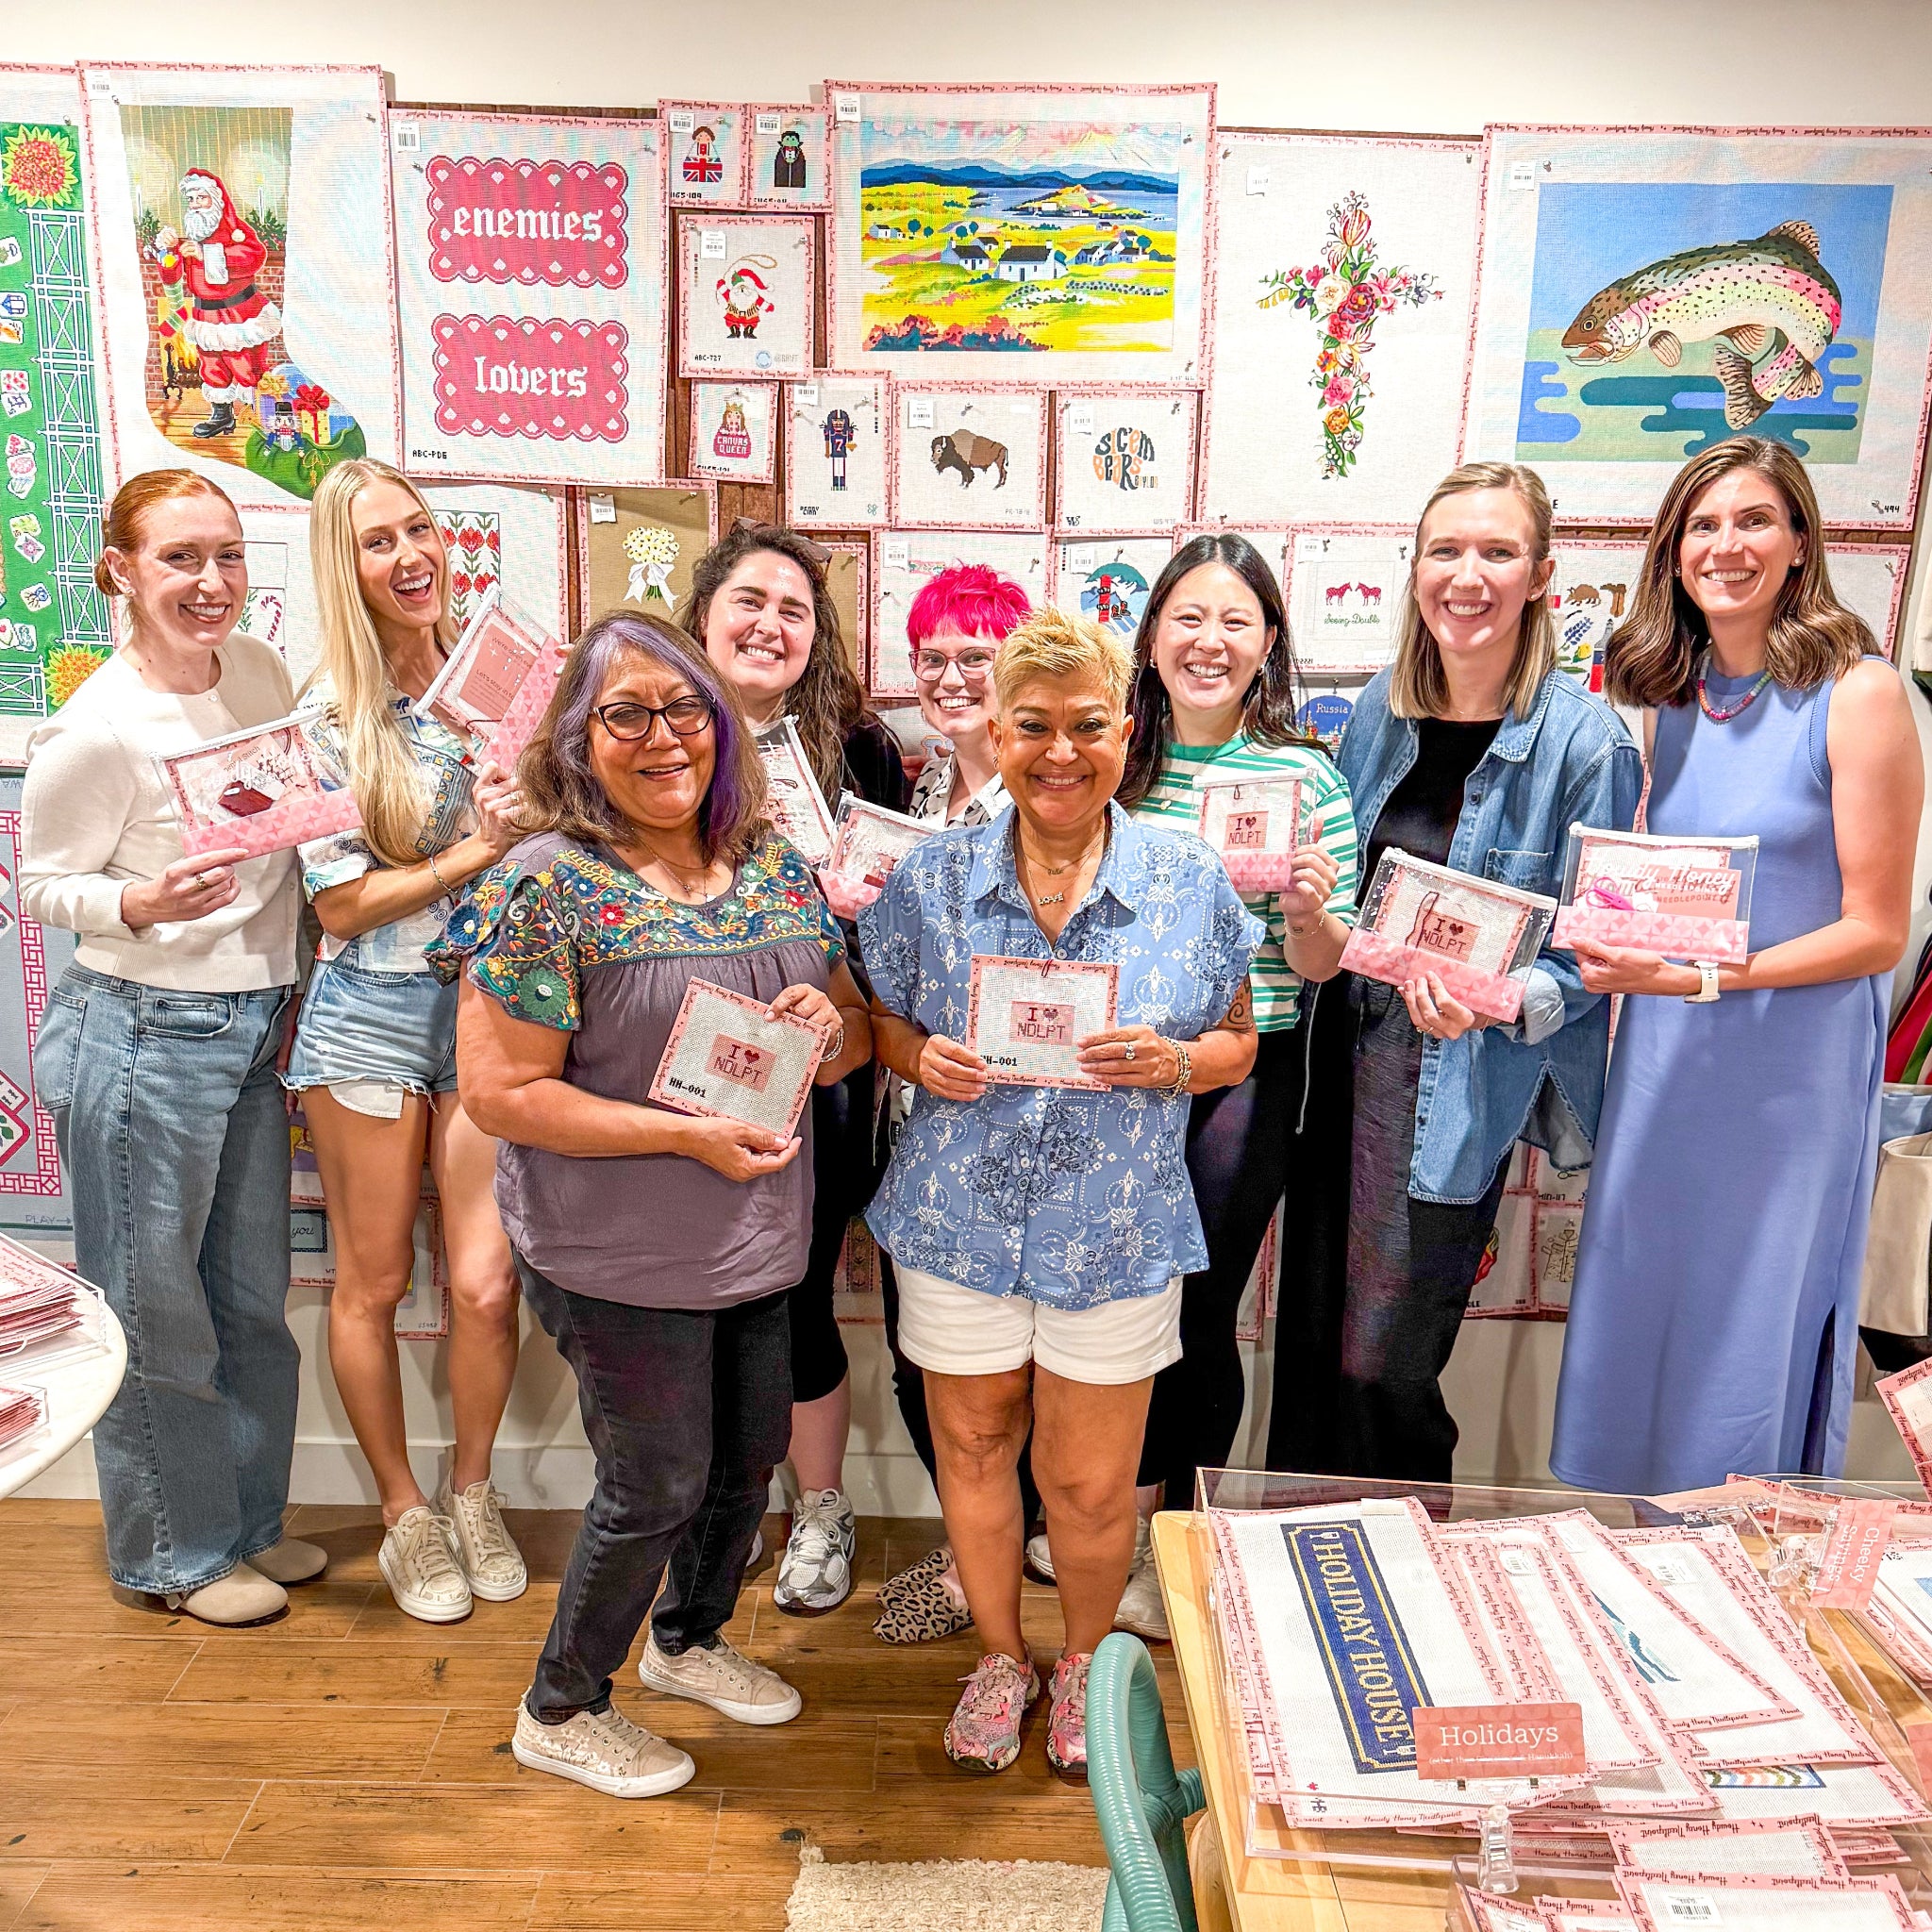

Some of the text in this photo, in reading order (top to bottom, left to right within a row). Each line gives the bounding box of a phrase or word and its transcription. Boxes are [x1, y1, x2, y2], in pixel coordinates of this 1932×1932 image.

[454, 202, 604, 242] enemies
[474, 356, 588, 397] lovers
[717, 436, 748, 446] CANVAS
[835, 440, 843, 453] 7
[719, 444, 746, 455] QUEEN
[1352, 613, 1380, 625] Double
[1316, 703, 1349, 714] Russia
[1235, 817, 1243, 831] I
[1227, 831, 1261, 844] NDLPT
[1668, 865, 1736, 895] Honey
[1433, 917, 1446, 932] I
[1421, 928, 1467, 955] NDLPT
[1027, 1007, 1039, 1022] I
[1017, 1022, 1066, 1040] NDLPT
[727, 1044, 741, 1060] I
[713, 1057, 763, 1083] NDLPT
[668, 1076, 707, 1098] HH-001
[25, 1214, 56, 1224] PLAY
[1884, 1390, 1899, 1414] Howdy
[1897, 1415, 1909, 1437] Honey
[1827, 1524, 1858, 1582] Sayings
[1850, 1526, 1880, 1583] Cheeky
[1311, 1541, 1415, 1743] HOLIDAY HOUSE
[1439, 1724, 1559, 1749] Holidays
[1777, 1812, 1824, 1829] Needlepoint
[1641, 1821, 1740, 1839] Howdy Honey Needlepoint
[1623, 1870, 1727, 1886] Howdy Honey Needlepoint
[1772, 1875, 1878, 1890] Howdy Honey Needlepoint
[1539, 1898, 1594, 1914] Howdy Honey
